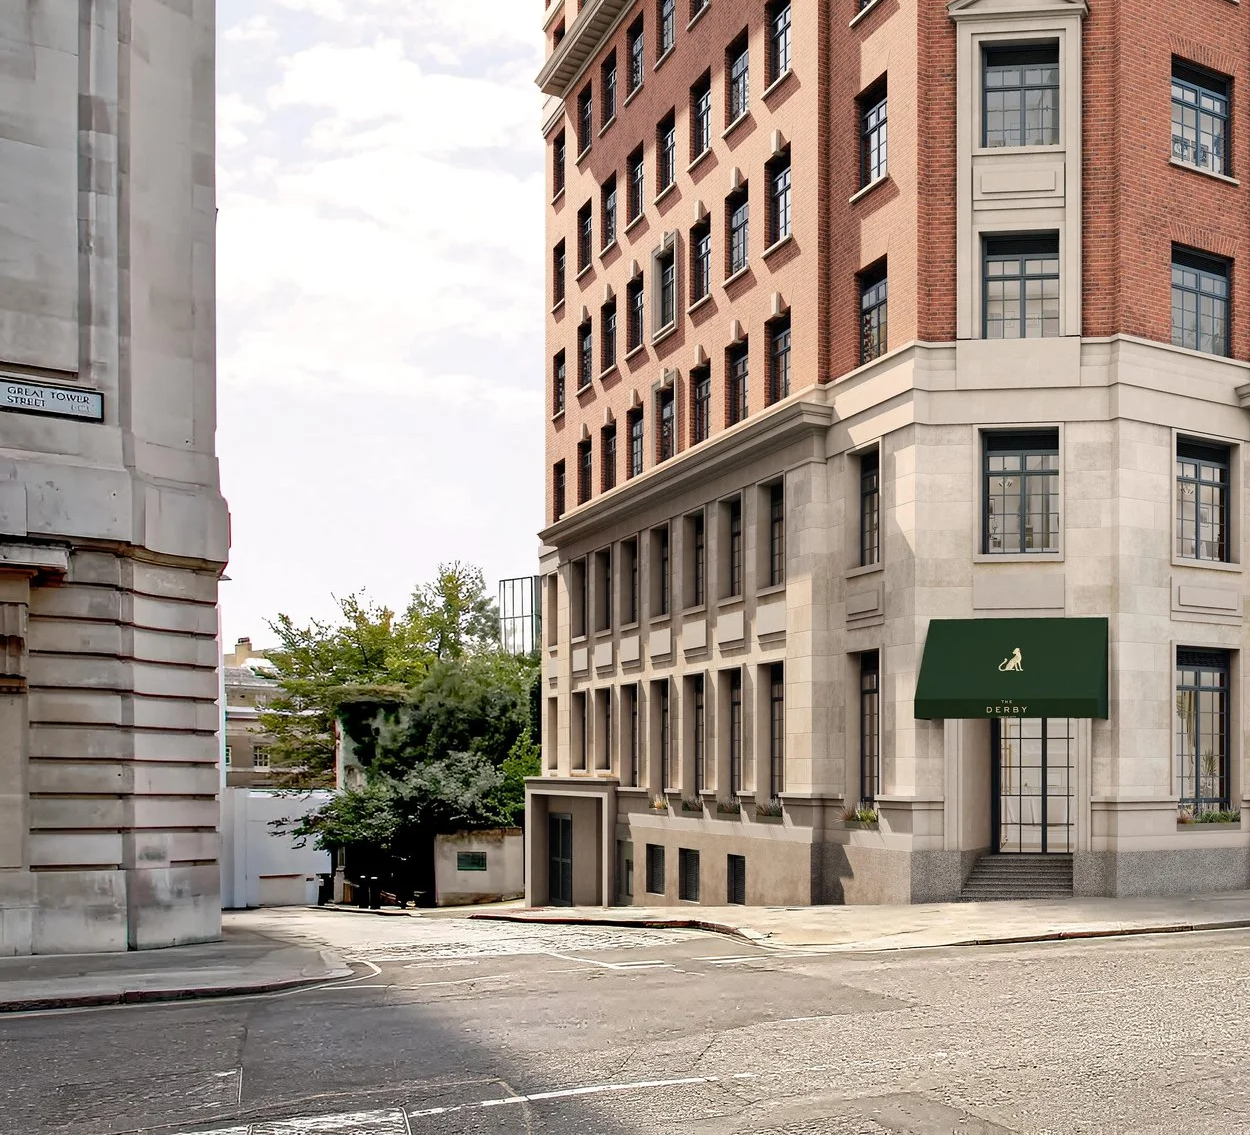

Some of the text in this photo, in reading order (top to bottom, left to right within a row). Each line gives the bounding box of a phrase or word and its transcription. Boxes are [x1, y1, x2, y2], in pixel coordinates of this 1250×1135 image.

[7, 386, 90, 404] GREAT TOWER
[7, 395, 45, 407] STREET
[986, 706, 1028, 714] DERBY
